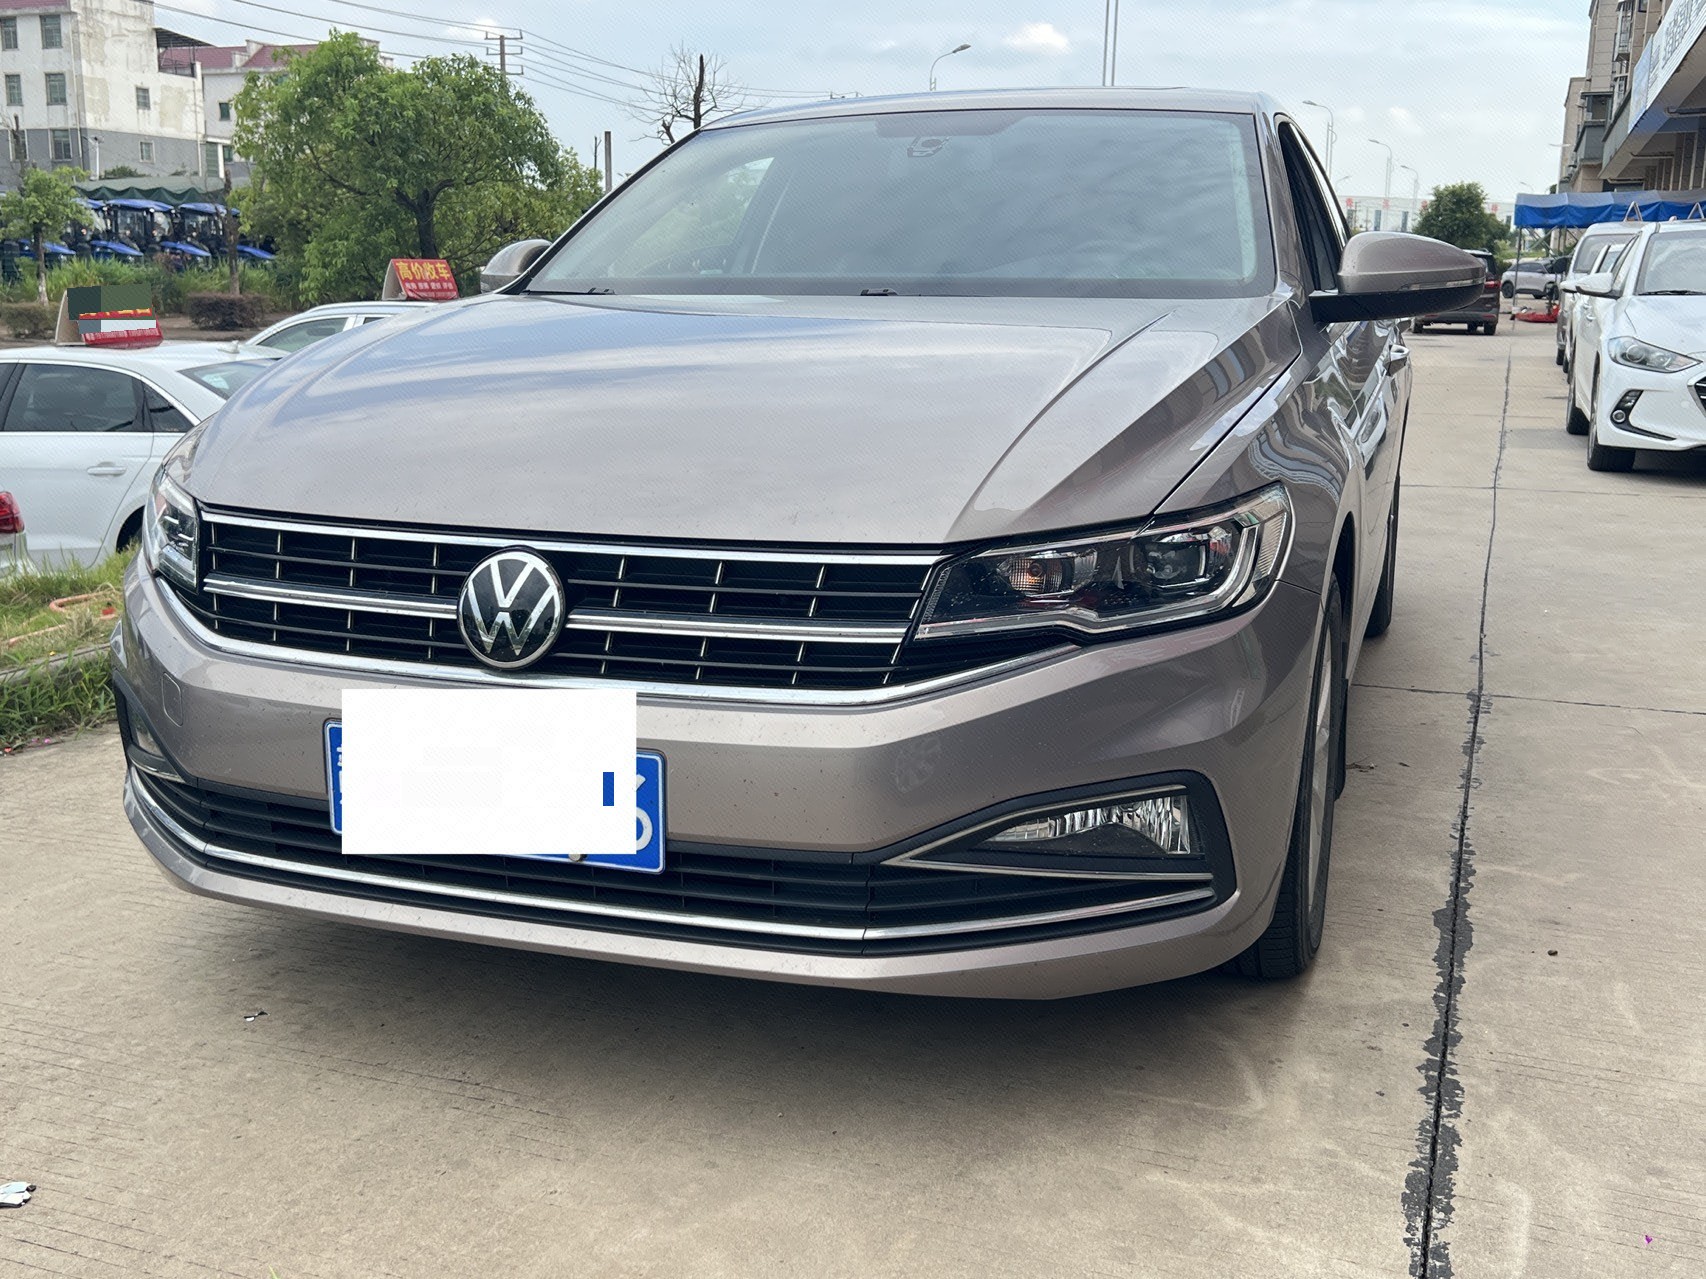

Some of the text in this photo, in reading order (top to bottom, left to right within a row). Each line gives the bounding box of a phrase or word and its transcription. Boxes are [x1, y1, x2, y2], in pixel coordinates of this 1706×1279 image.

[395, 261, 451, 281] 高价收车
[464, 552, 560, 662] VW
